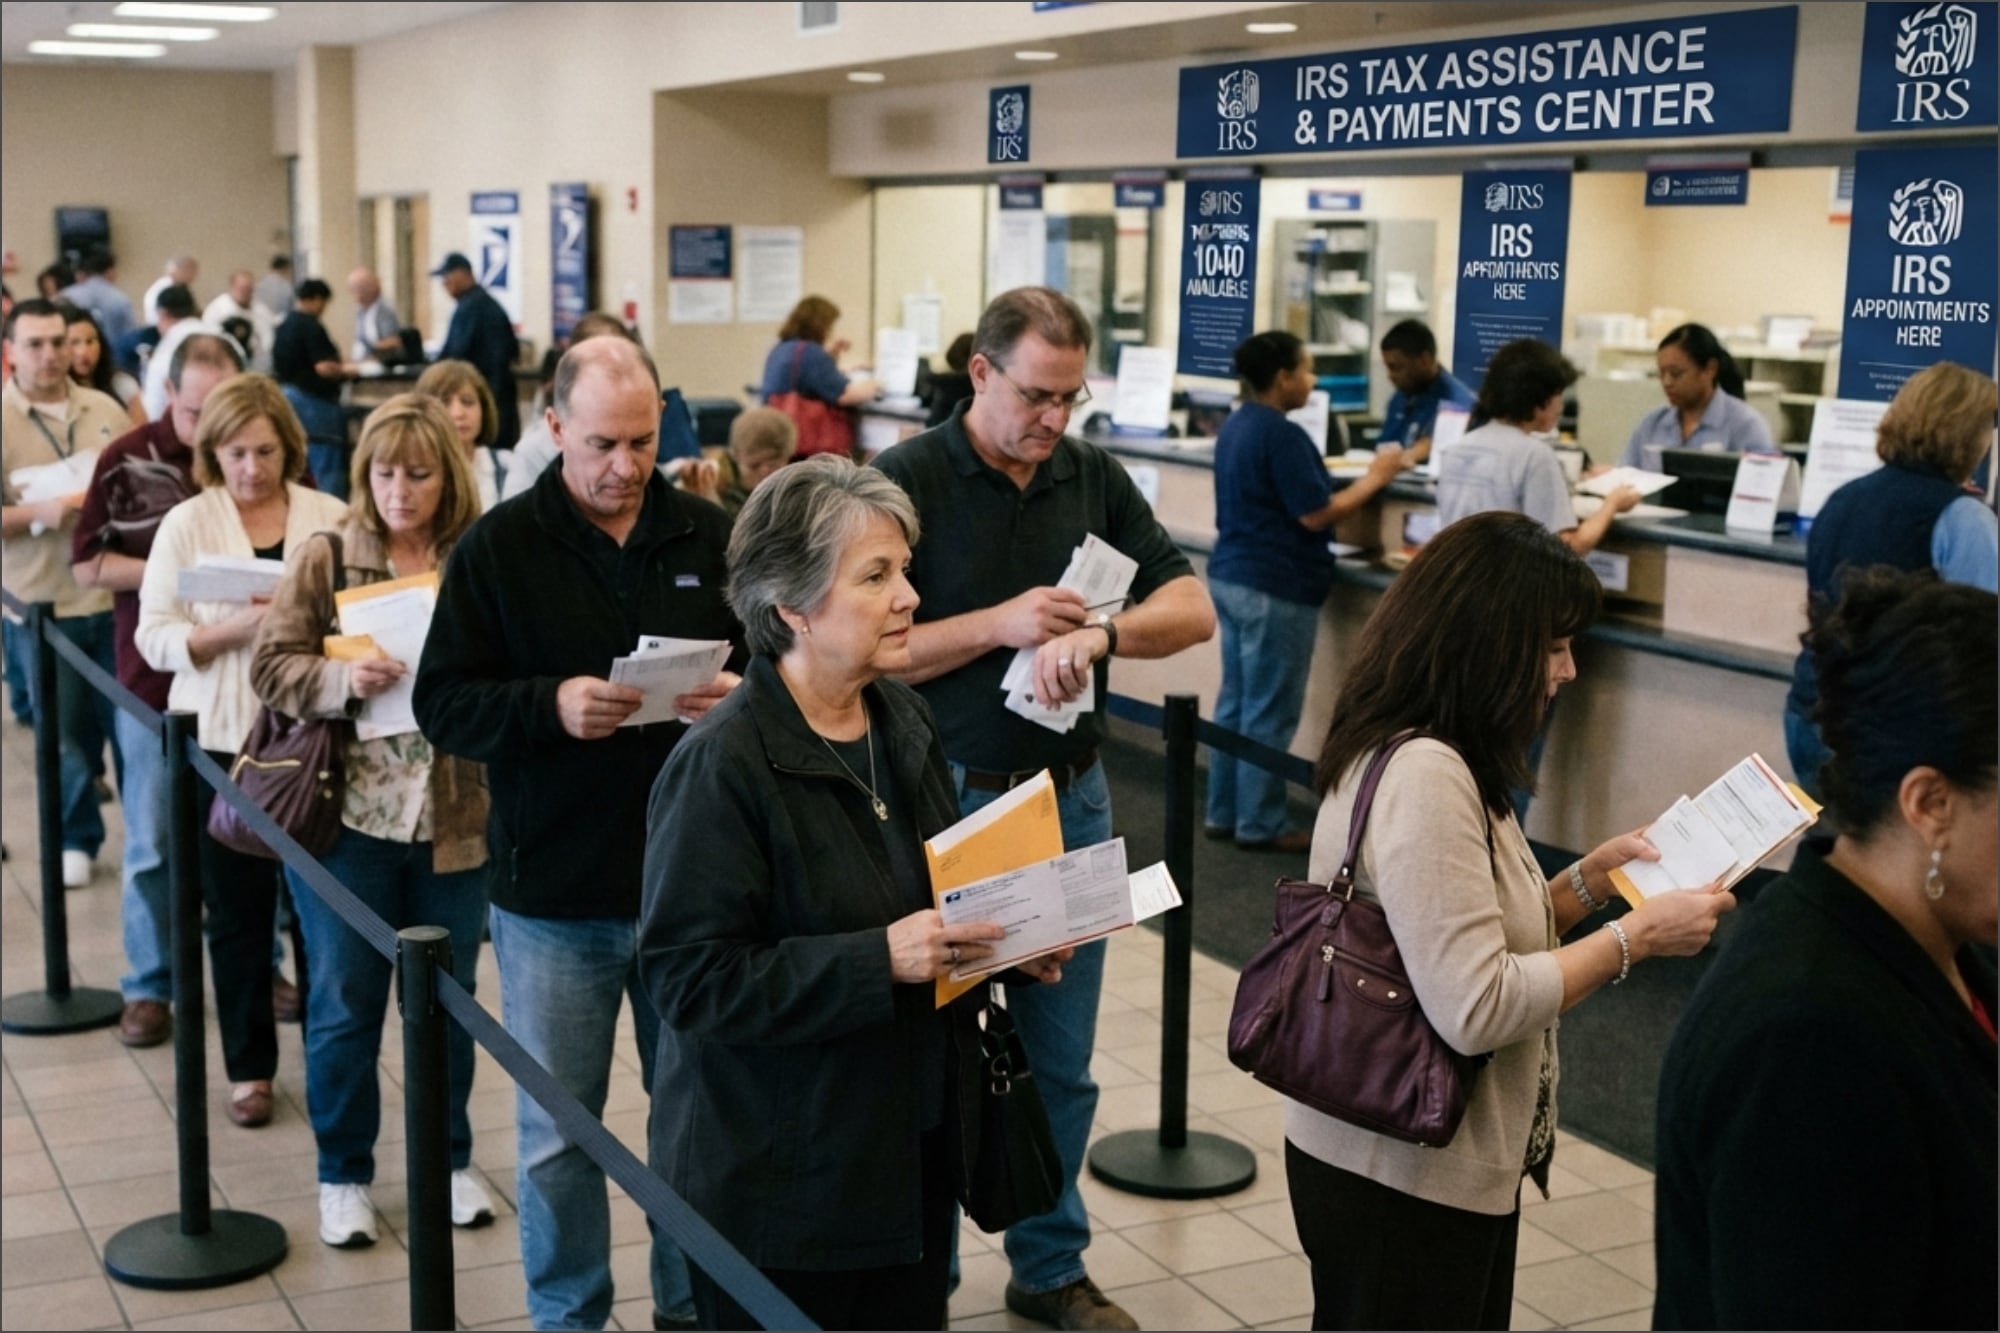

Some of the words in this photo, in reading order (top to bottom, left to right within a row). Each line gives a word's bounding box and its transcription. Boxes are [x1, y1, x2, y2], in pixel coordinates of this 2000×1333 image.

[1296, 62, 1349, 101] IRS
[1360, 53, 1428, 96] TAX
[1436, 26, 1707, 91] ASSISTANCE
[1294, 109, 1318, 145] &
[1327, 95, 1522, 143] PAYMENTS
[1535, 81, 1716, 133] CENTER
[1891, 78, 1971, 122] IRS
[1217, 120, 1258, 151] IRS
[1490, 223, 1534, 258] IRS
[1891, 254, 1952, 296] IRS
[1851, 298, 1991, 324] APPOINTMENTS
